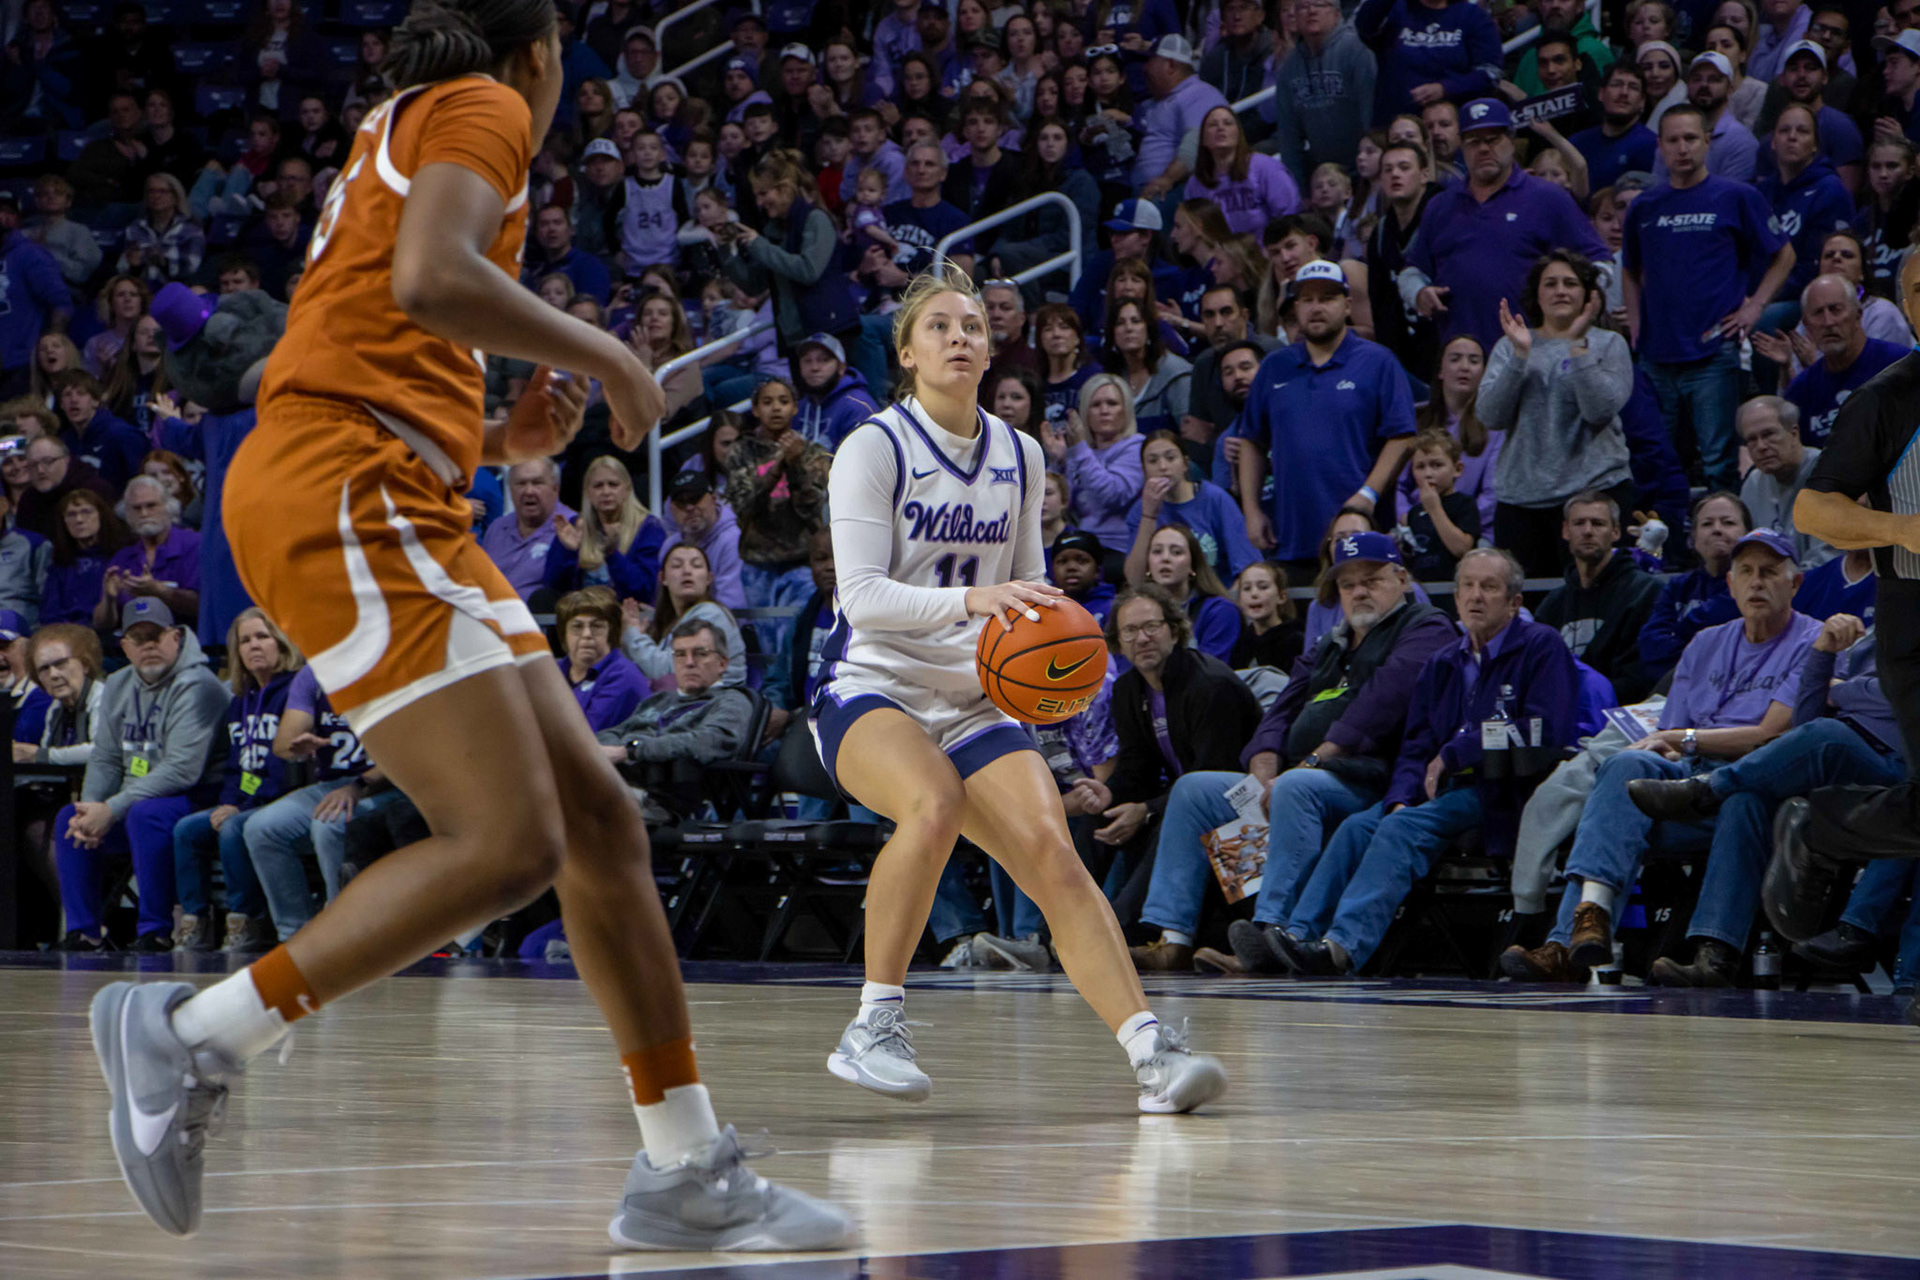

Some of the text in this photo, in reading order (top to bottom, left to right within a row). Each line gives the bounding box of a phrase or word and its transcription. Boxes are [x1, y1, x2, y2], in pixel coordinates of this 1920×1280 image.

[637, 211, 662, 229] 24
[1656, 212, 1718, 227] K-STATE
[904, 501, 1011, 544] Wildcat
[935, 553, 980, 588] 11
[1654, 907, 1673, 923] 15
